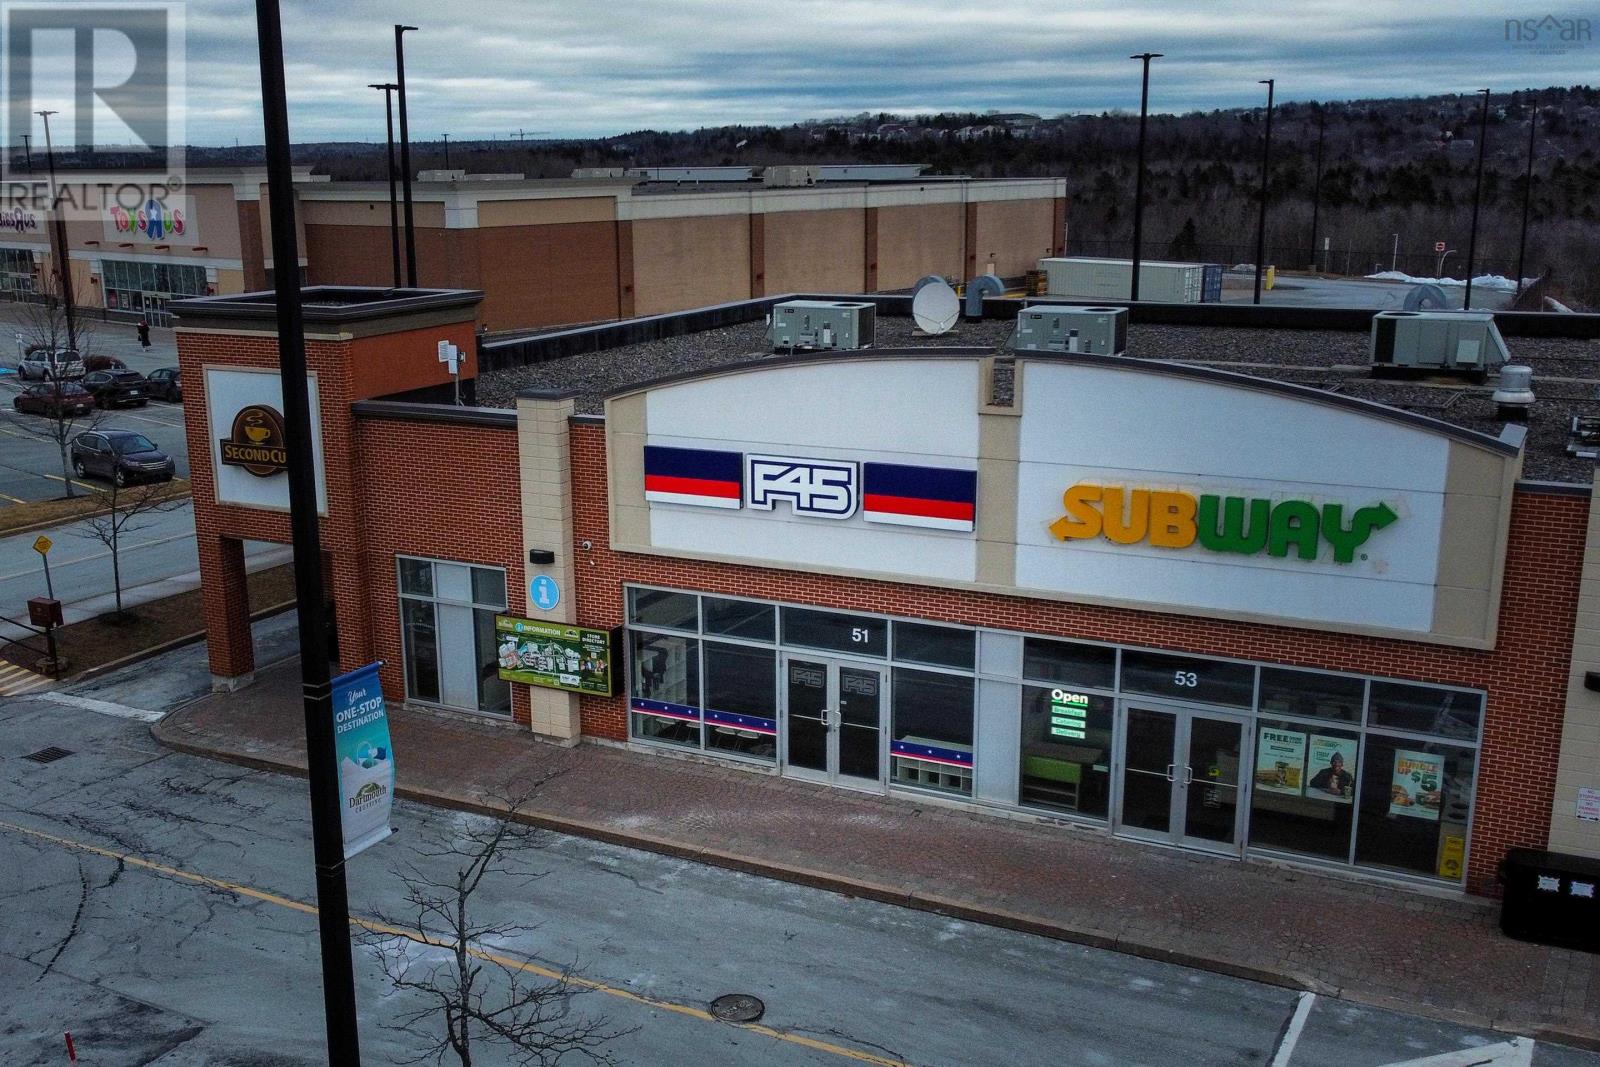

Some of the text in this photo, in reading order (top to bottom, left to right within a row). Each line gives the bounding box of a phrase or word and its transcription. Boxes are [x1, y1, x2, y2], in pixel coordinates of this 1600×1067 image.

[224, 445, 287, 463] SECOND CU
[750, 458, 852, 516] F45
[1048, 484, 1398, 563] SUBWAY
[523, 624, 561, 636] INFORMATION
[852, 628, 869, 643] 51
[792, 667, 824, 688] F45
[843, 675, 877, 696] F45
[1174, 671, 1198, 687] 53
[347, 688, 367, 705] Your
[1051, 689, 1088, 704] Open
[336, 696, 382, 723] ONE-STOP
[1054, 706, 1083, 716] Breakfast
[337, 709, 384, 734] DESTINATION
[1056, 728, 1081, 738] Delivery
[1264, 732, 1289, 743] FREE
[1411, 770, 1438, 792] $5
[349, 785, 387, 809] Dartmouth
